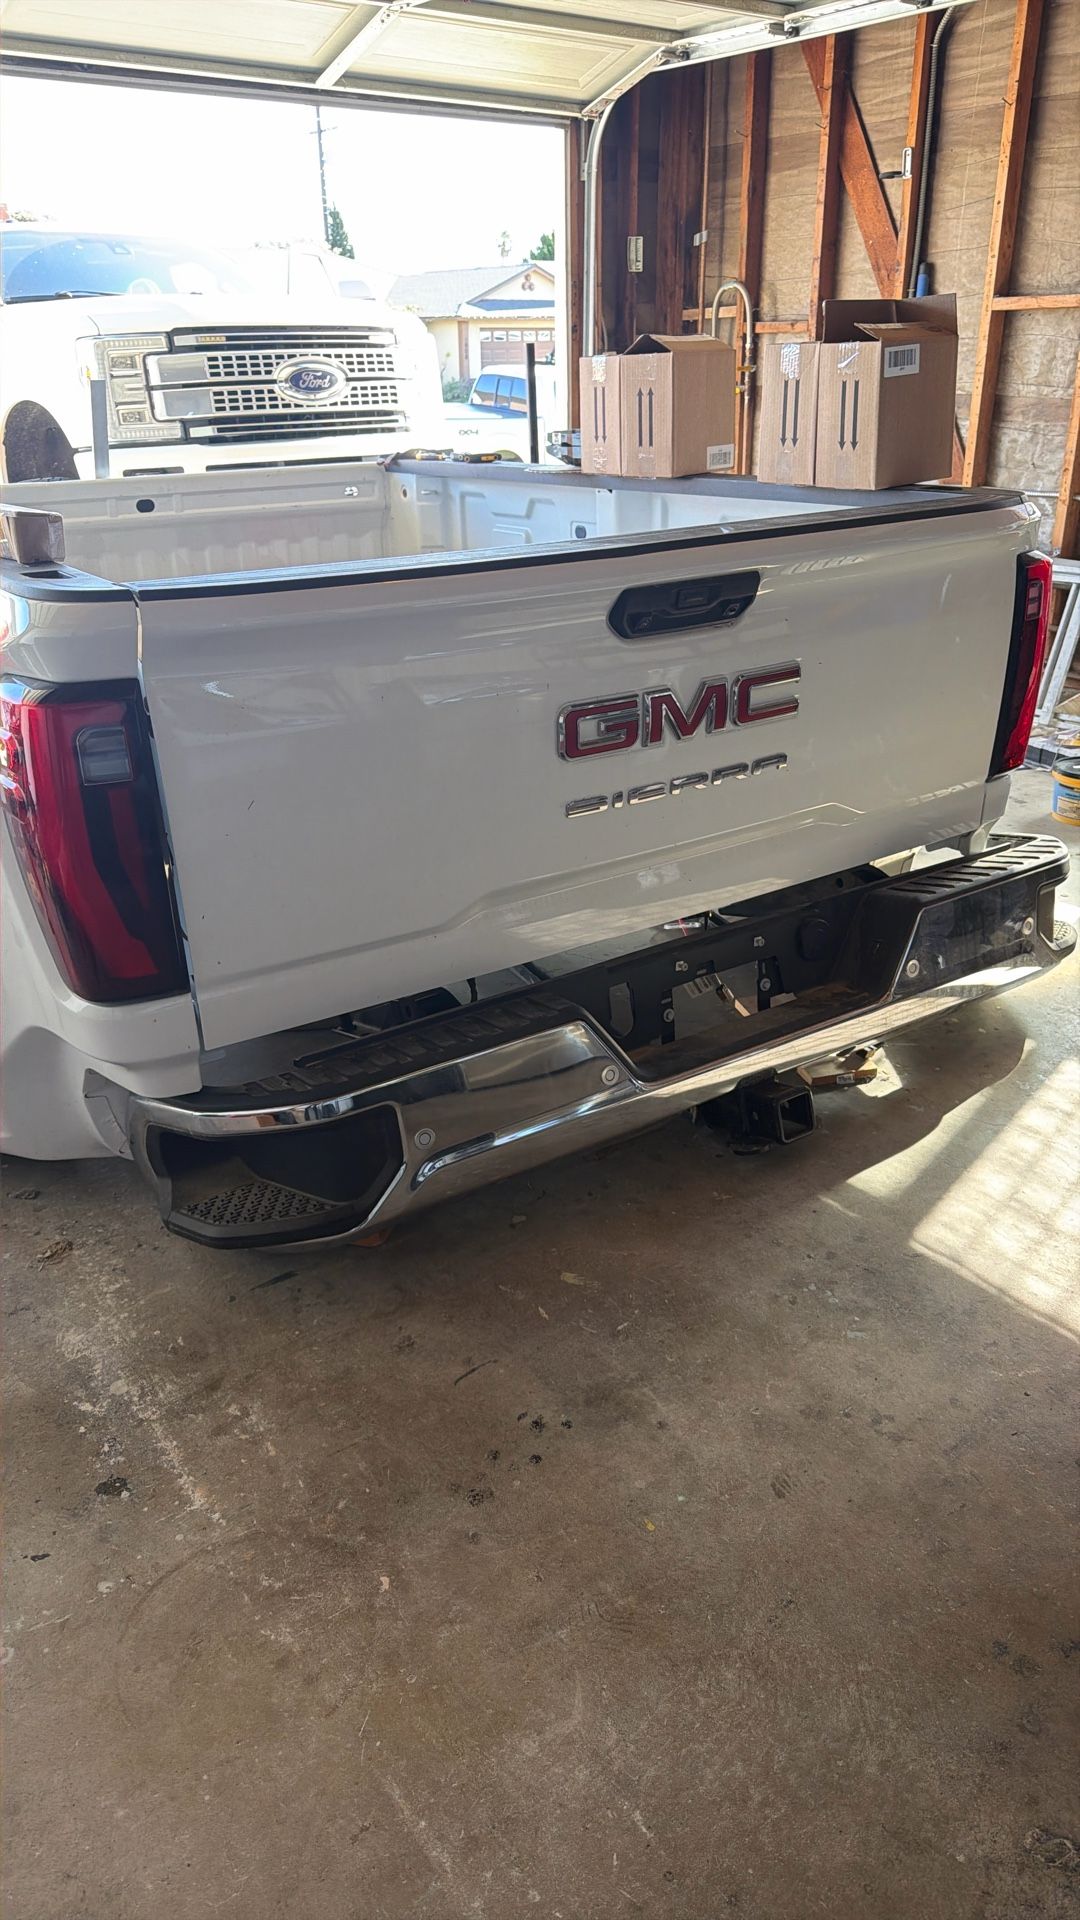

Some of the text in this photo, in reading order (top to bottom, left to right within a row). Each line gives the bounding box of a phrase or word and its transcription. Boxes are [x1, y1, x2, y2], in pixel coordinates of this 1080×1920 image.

[299, 371, 331, 388] Ford
[557, 659, 801, 761] GMC
[565, 752, 788, 818] SIERRA
